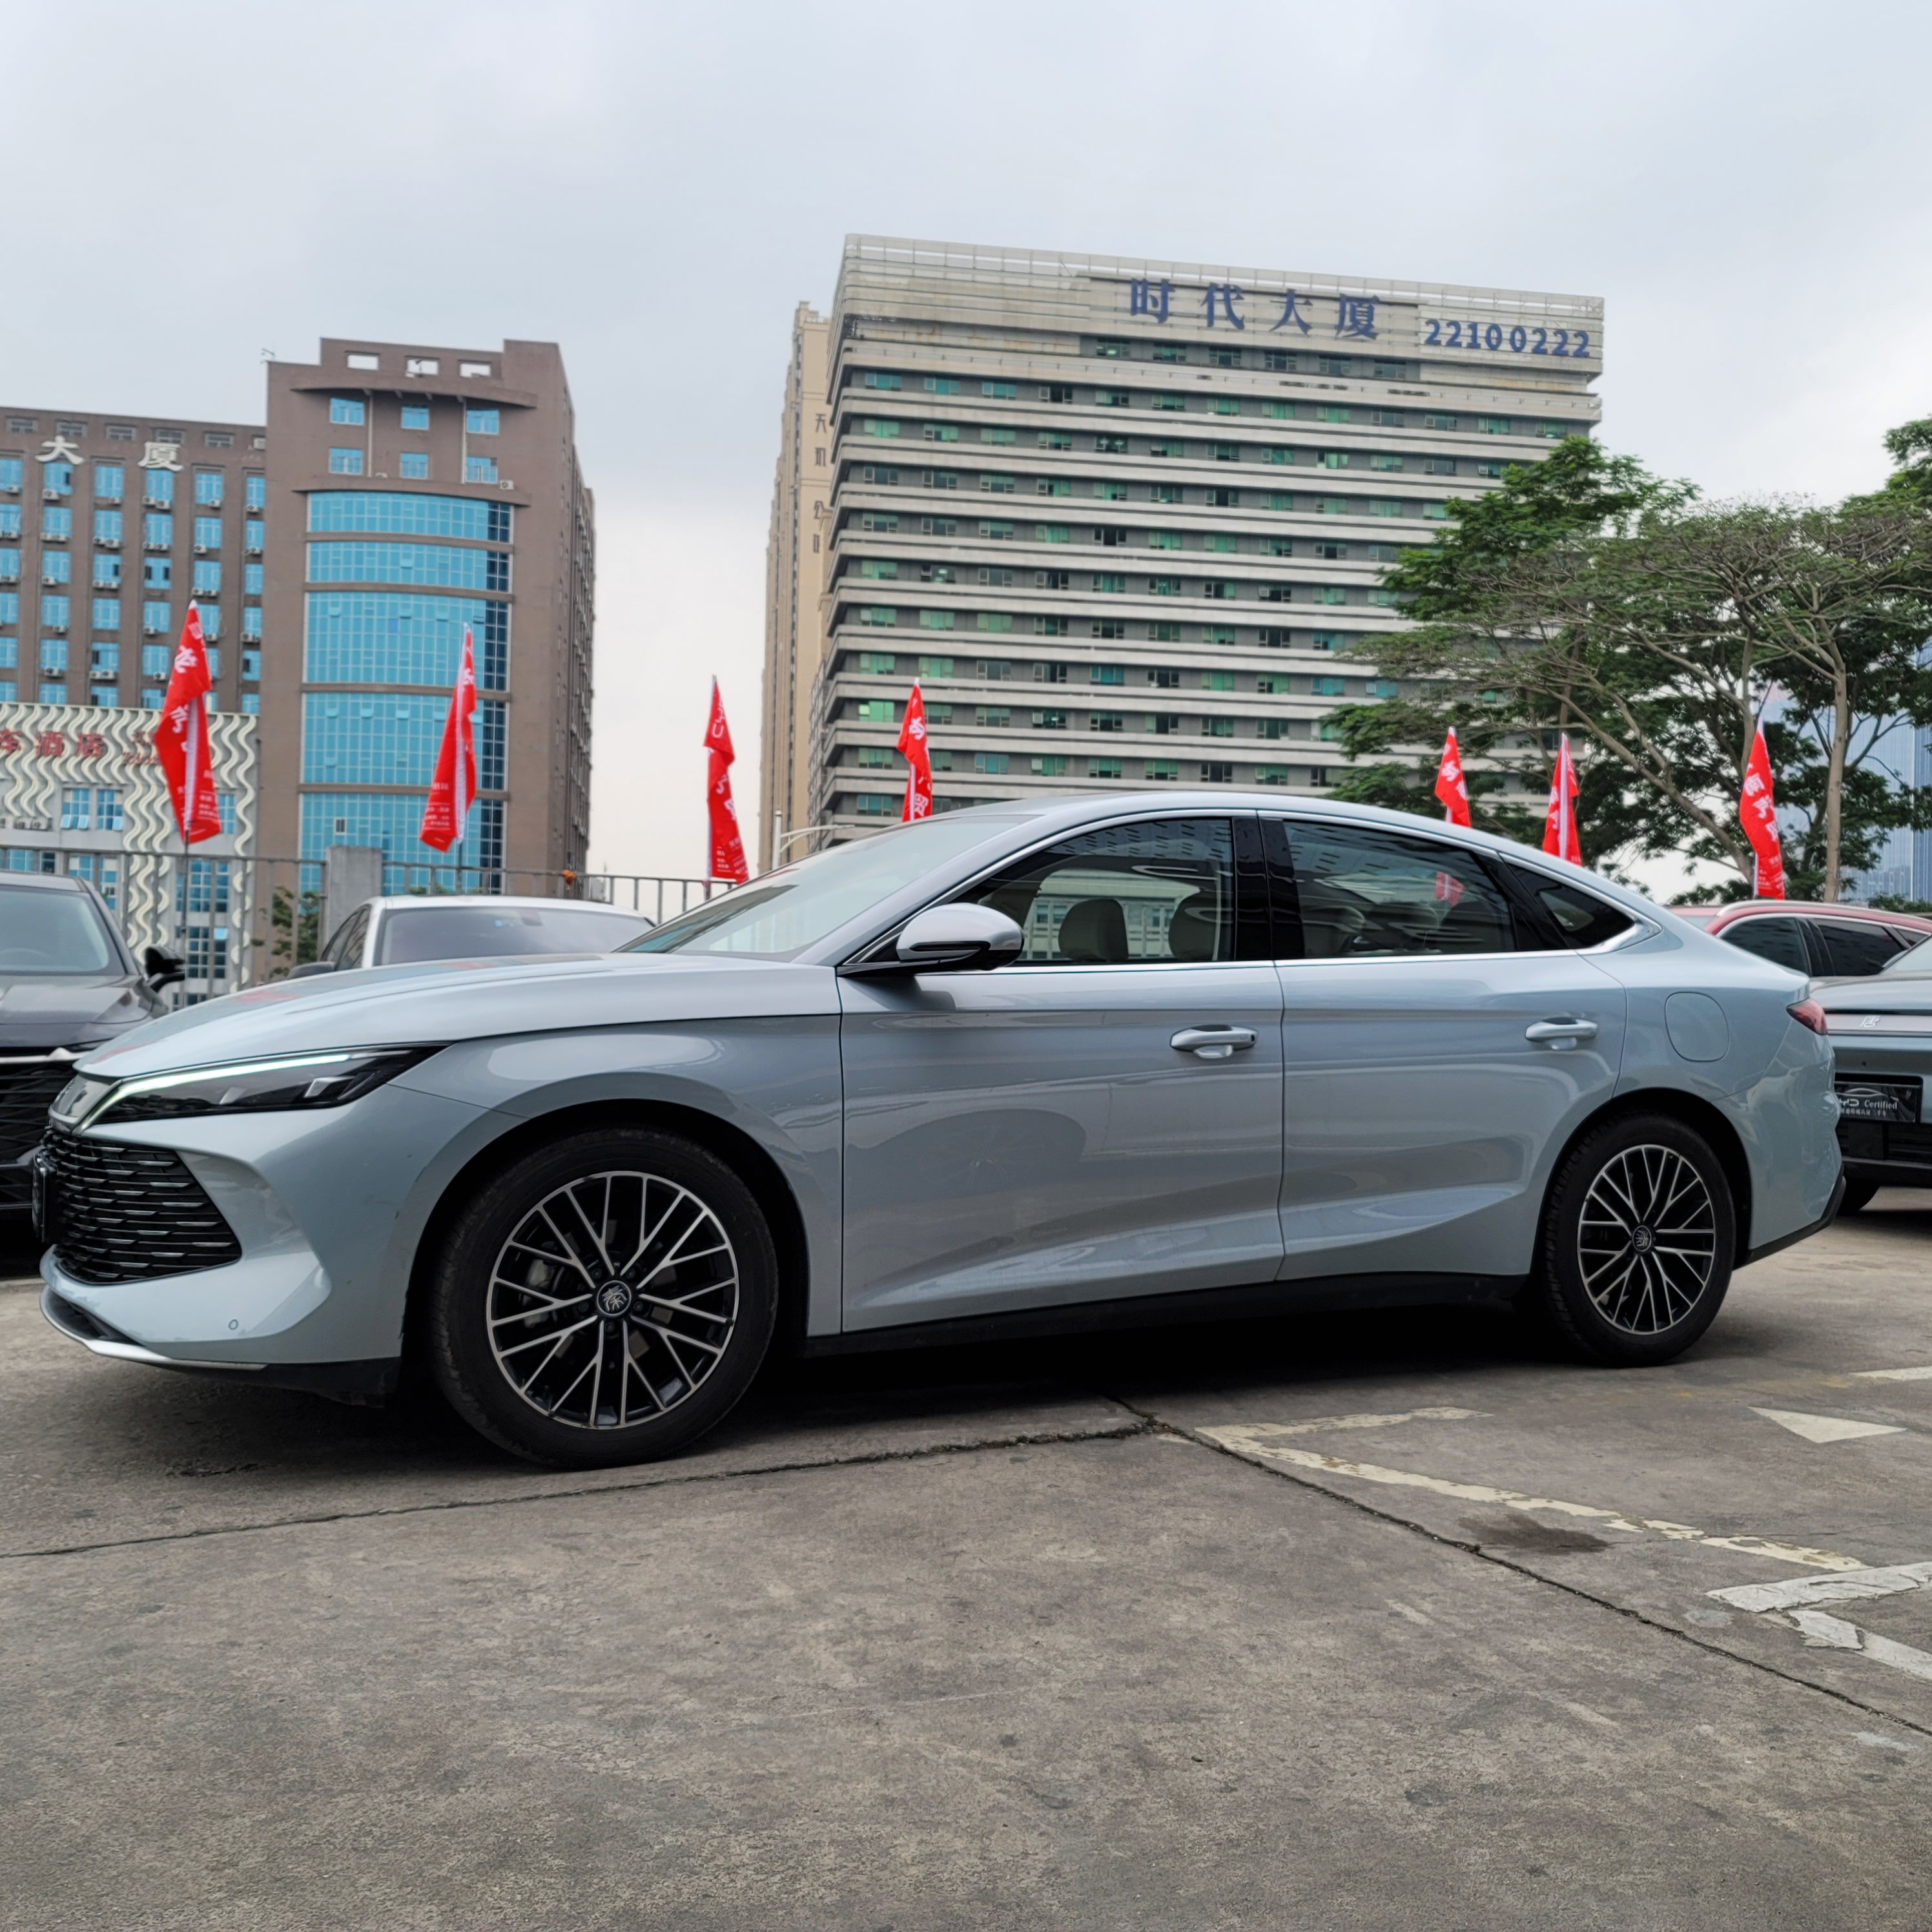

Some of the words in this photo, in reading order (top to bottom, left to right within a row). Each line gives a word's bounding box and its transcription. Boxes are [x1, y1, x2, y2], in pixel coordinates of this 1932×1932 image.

[1129, 277, 1380, 340] 时代大厦
[1424, 318, 1590, 358] 22100222
[34, 435, 185, 472] 大厦
[1864, 1099, 1898, 1110] Certified
